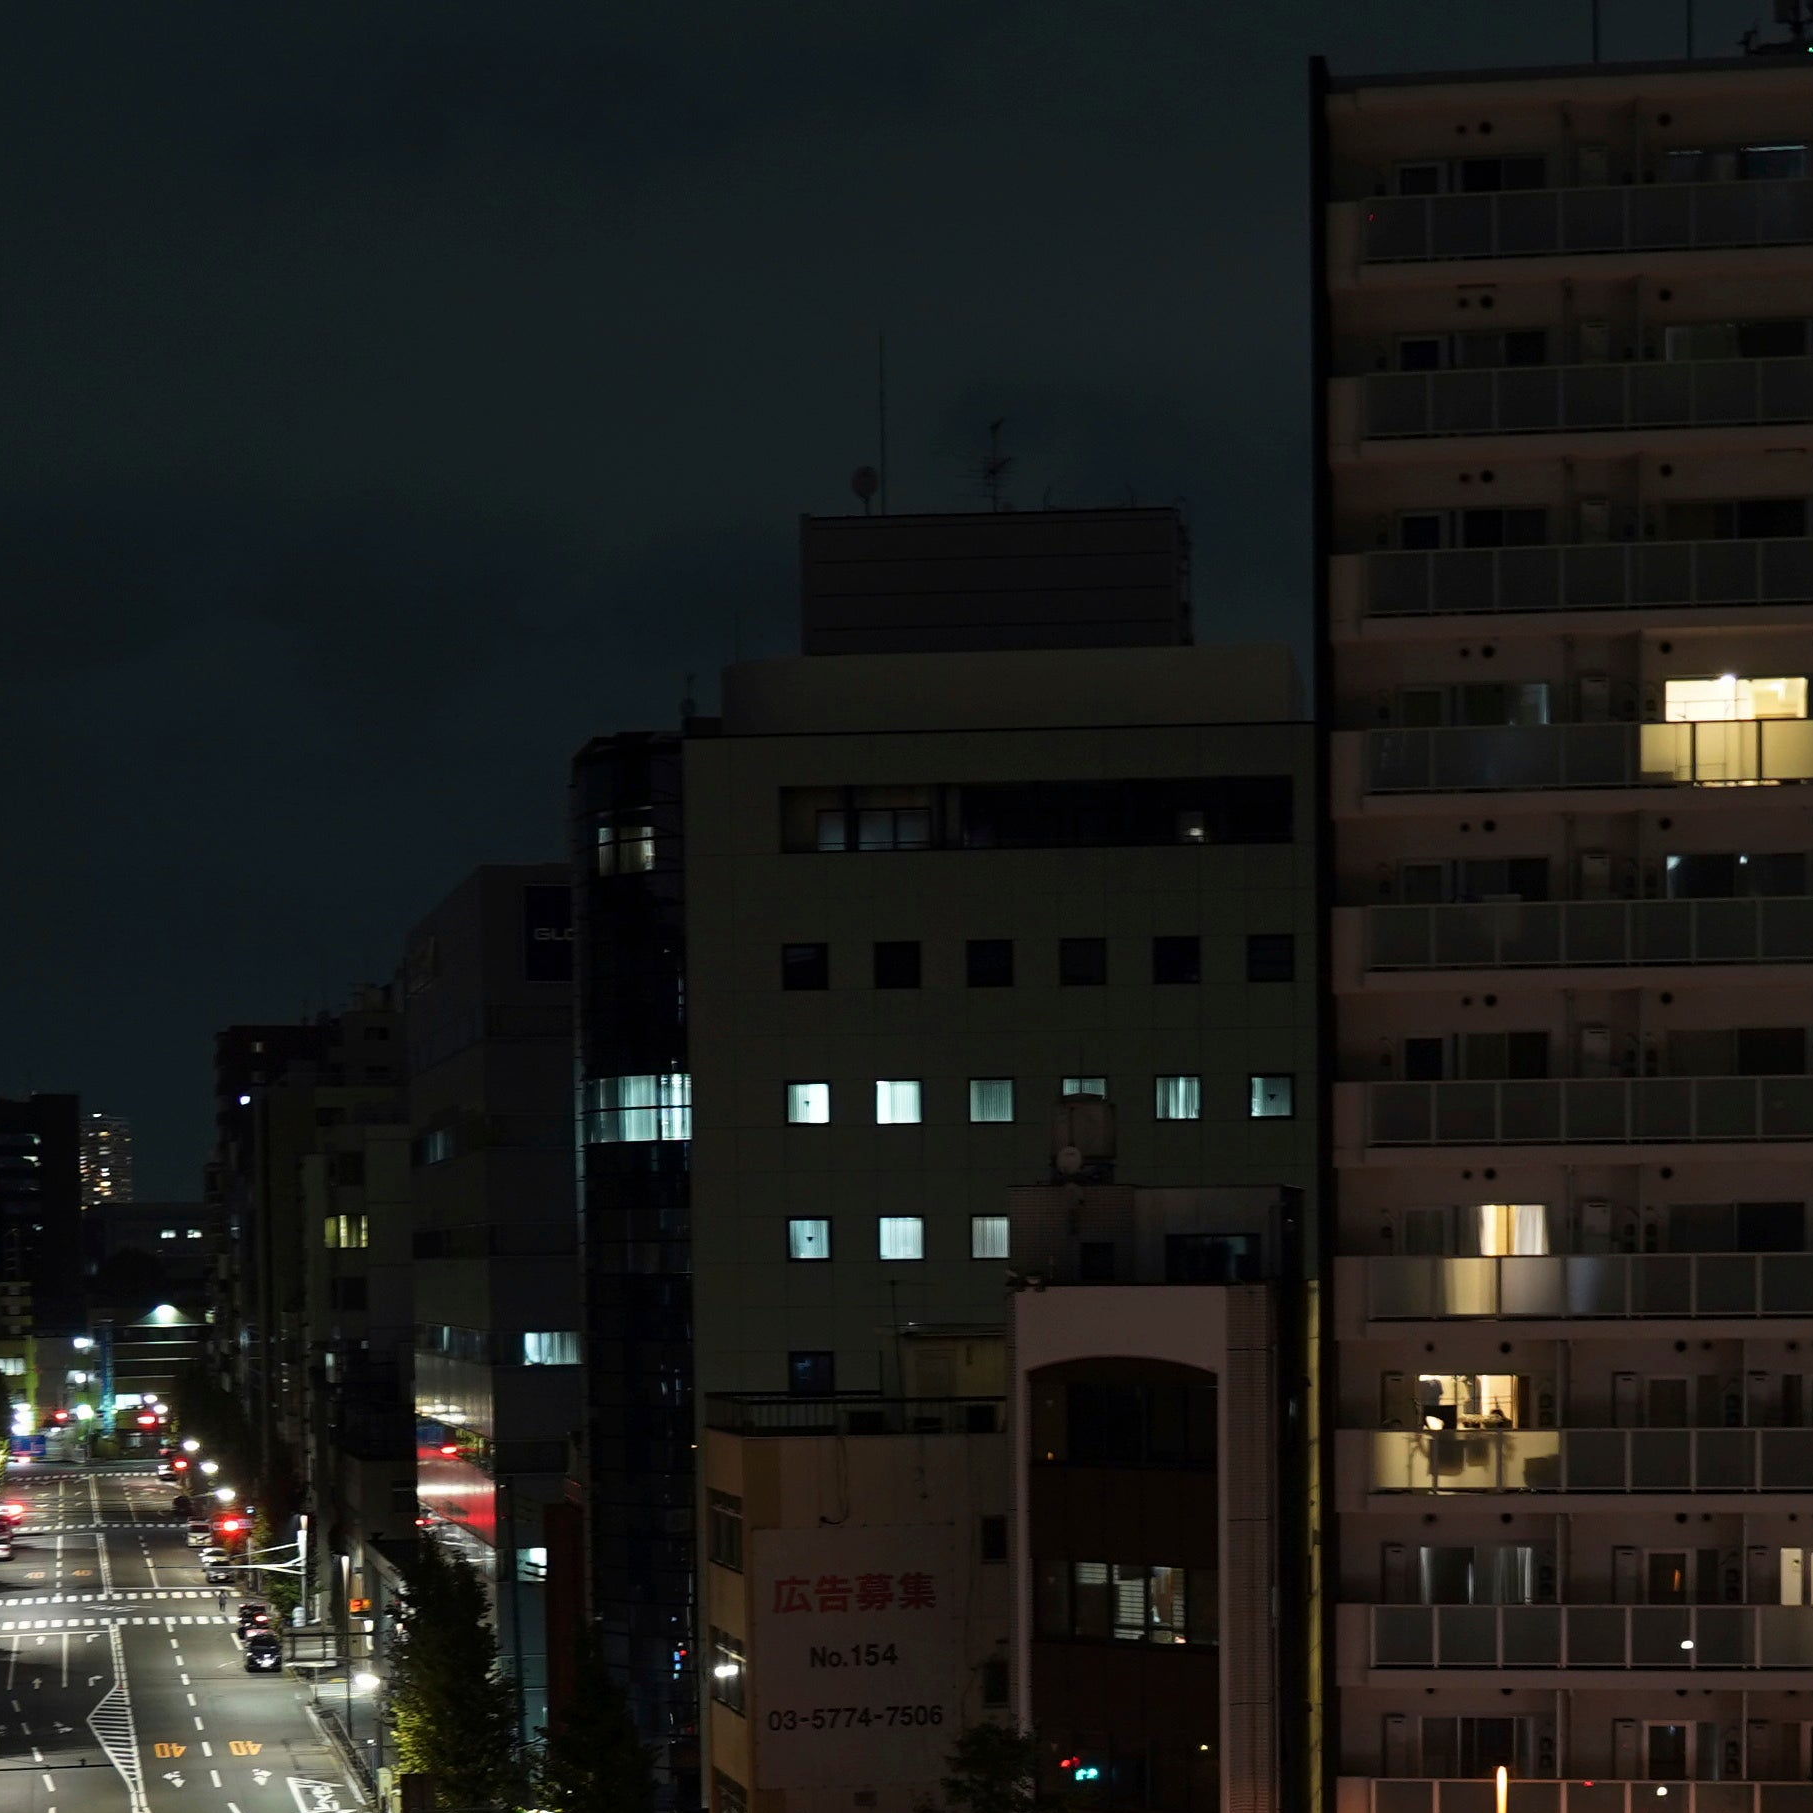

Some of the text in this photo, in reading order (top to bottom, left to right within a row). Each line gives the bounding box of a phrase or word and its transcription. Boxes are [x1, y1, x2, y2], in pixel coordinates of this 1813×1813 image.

[772, 1571, 938, 1614] 広告募集
[809, 1642, 900, 1669] No.154
[767, 1704, 944, 1732] 03-5774-7506
